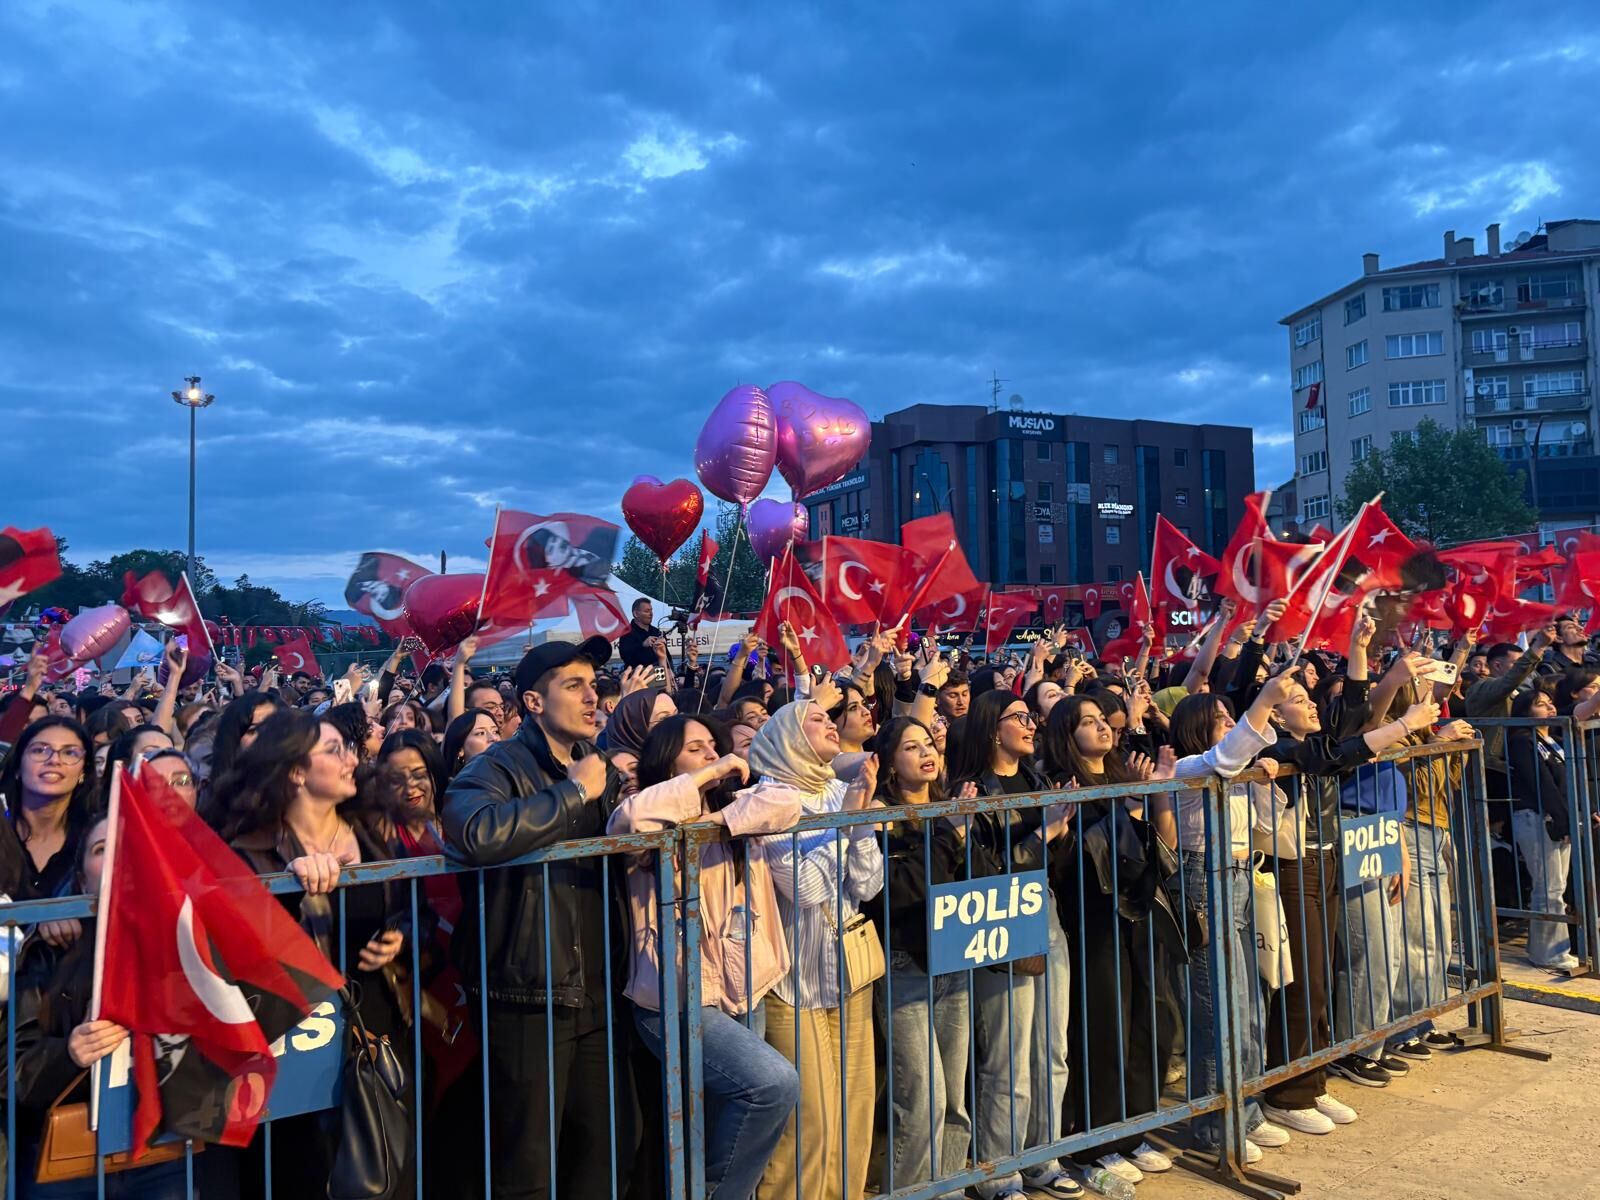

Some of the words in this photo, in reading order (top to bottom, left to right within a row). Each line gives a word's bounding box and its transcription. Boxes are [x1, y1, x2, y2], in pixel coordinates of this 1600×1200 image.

[1344, 816, 1399, 856] POLİS
[1359, 852, 1382, 878] 40
[934, 876, 1043, 930] POLİS
[964, 926, 1009, 964] 40
